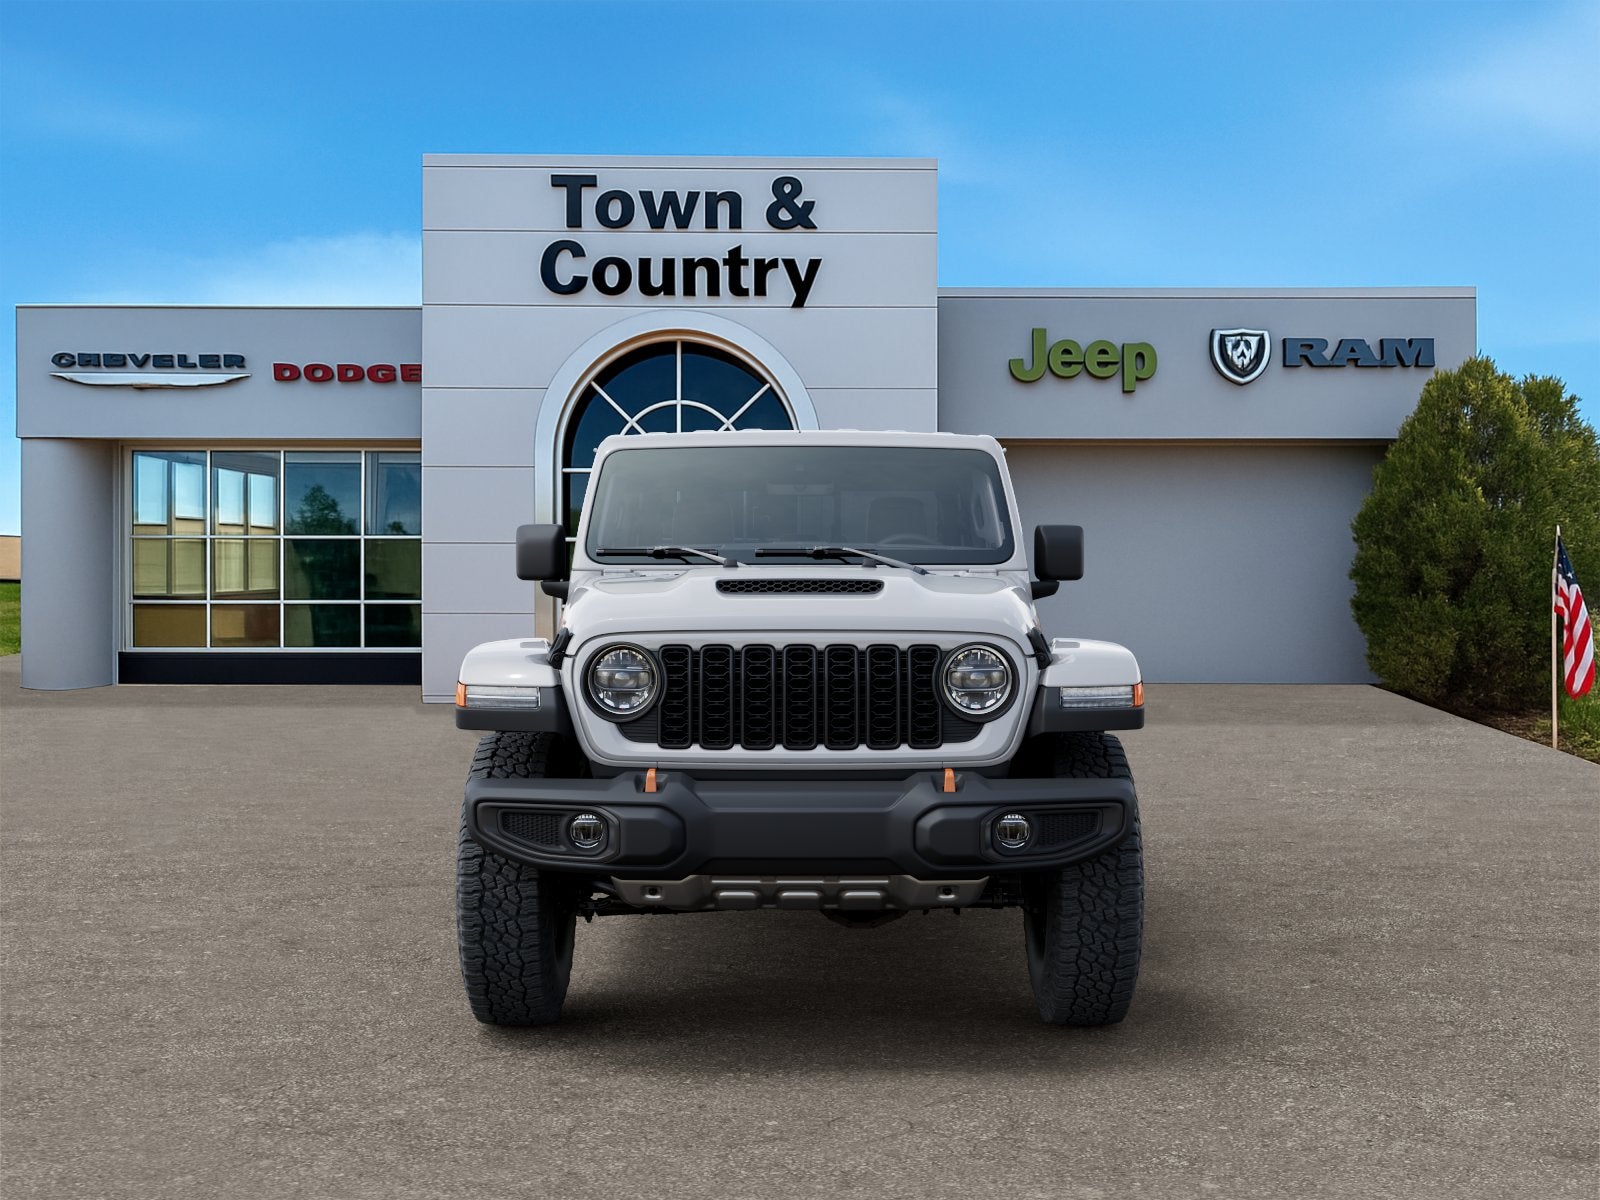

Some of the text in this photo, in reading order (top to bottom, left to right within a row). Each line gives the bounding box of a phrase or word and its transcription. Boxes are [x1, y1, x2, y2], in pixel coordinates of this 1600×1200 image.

[551, 174, 818, 230] Town &
[540, 239, 822, 308] Country
[273, 363, 422, 382] DODGE
[1008, 328, 1158, 393] Jeep
[1282, 337, 1435, 368] RAM
